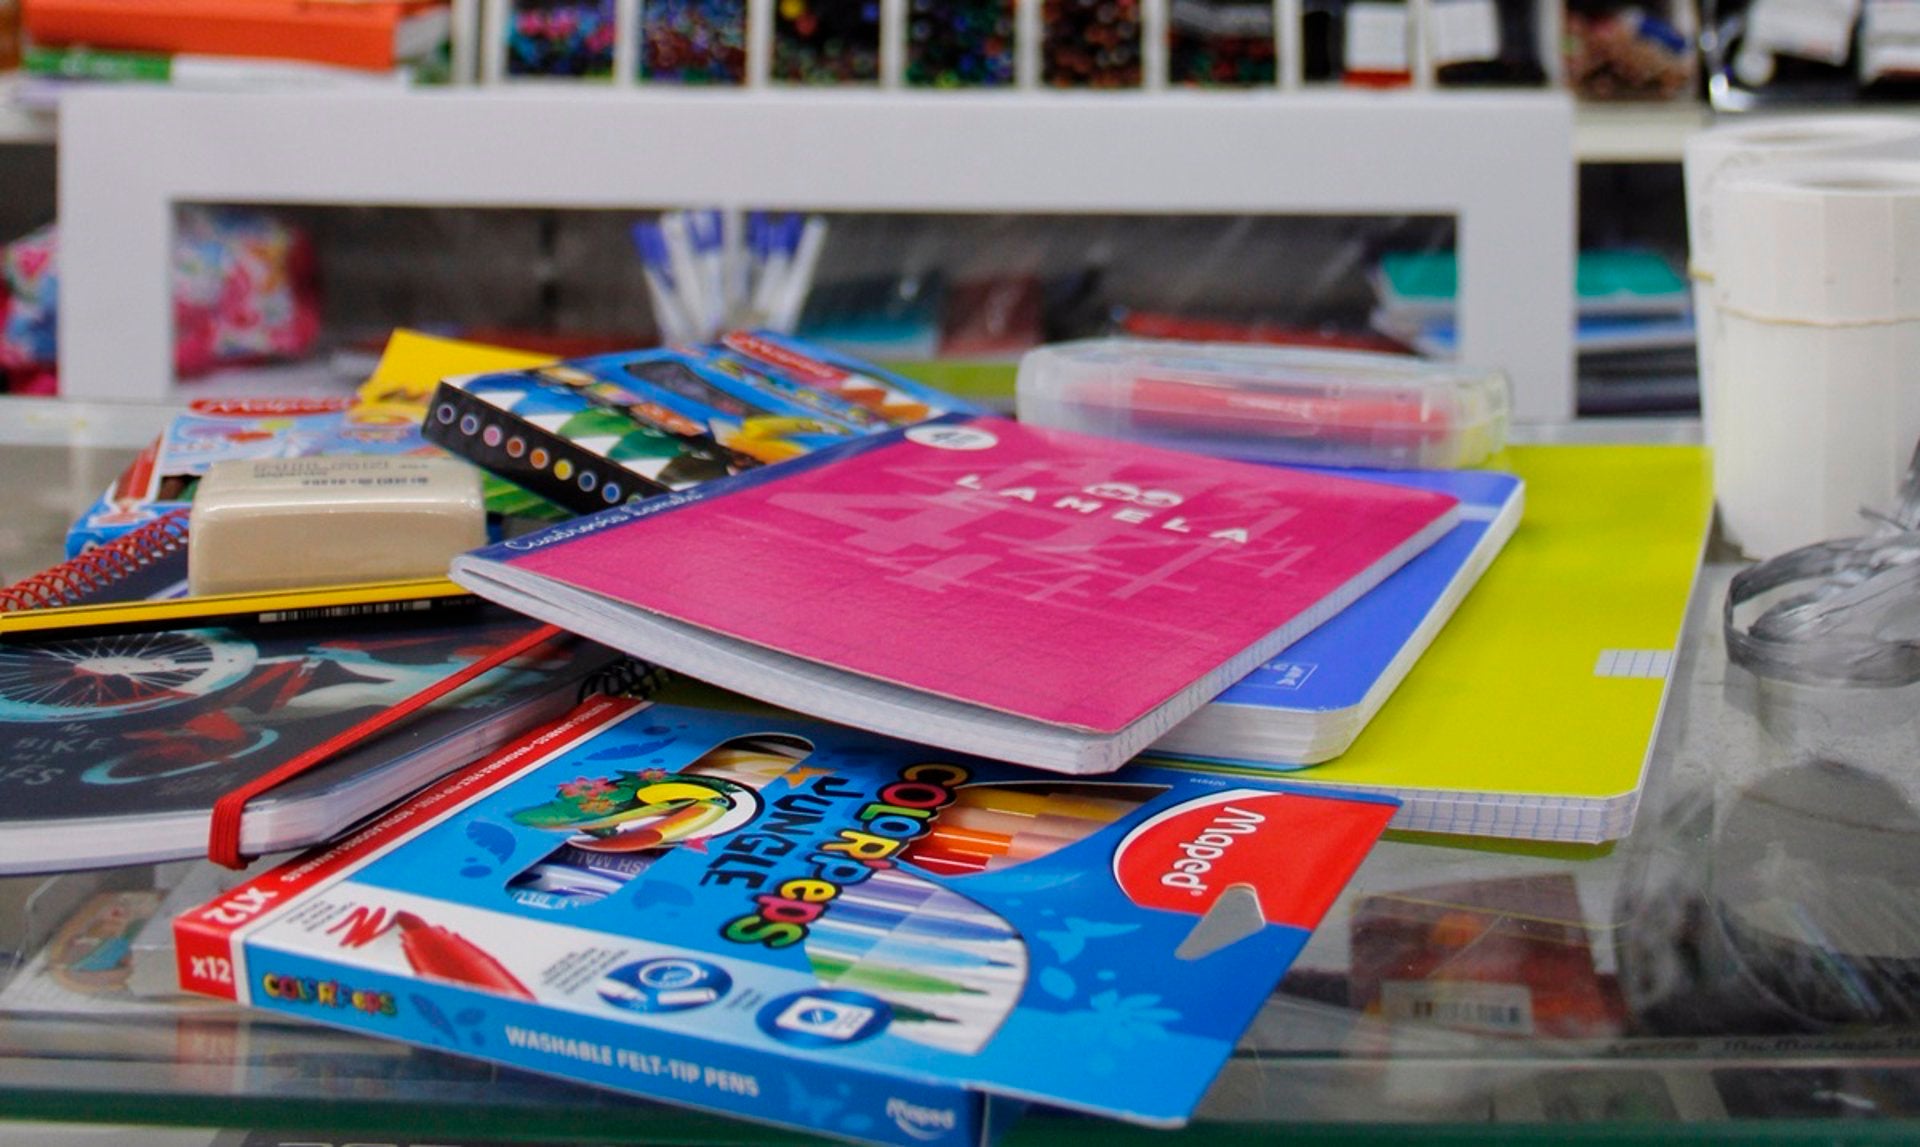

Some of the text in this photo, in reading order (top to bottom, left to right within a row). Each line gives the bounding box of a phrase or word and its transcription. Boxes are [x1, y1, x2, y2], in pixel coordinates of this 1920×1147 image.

[955, 473, 1249, 543] LAMELA
[698, 775, 866, 889] JUNGLE
[1160, 805, 1267, 892] Maped
[505, 1025, 761, 1098] WASHABLE FELT-TIP PENS
